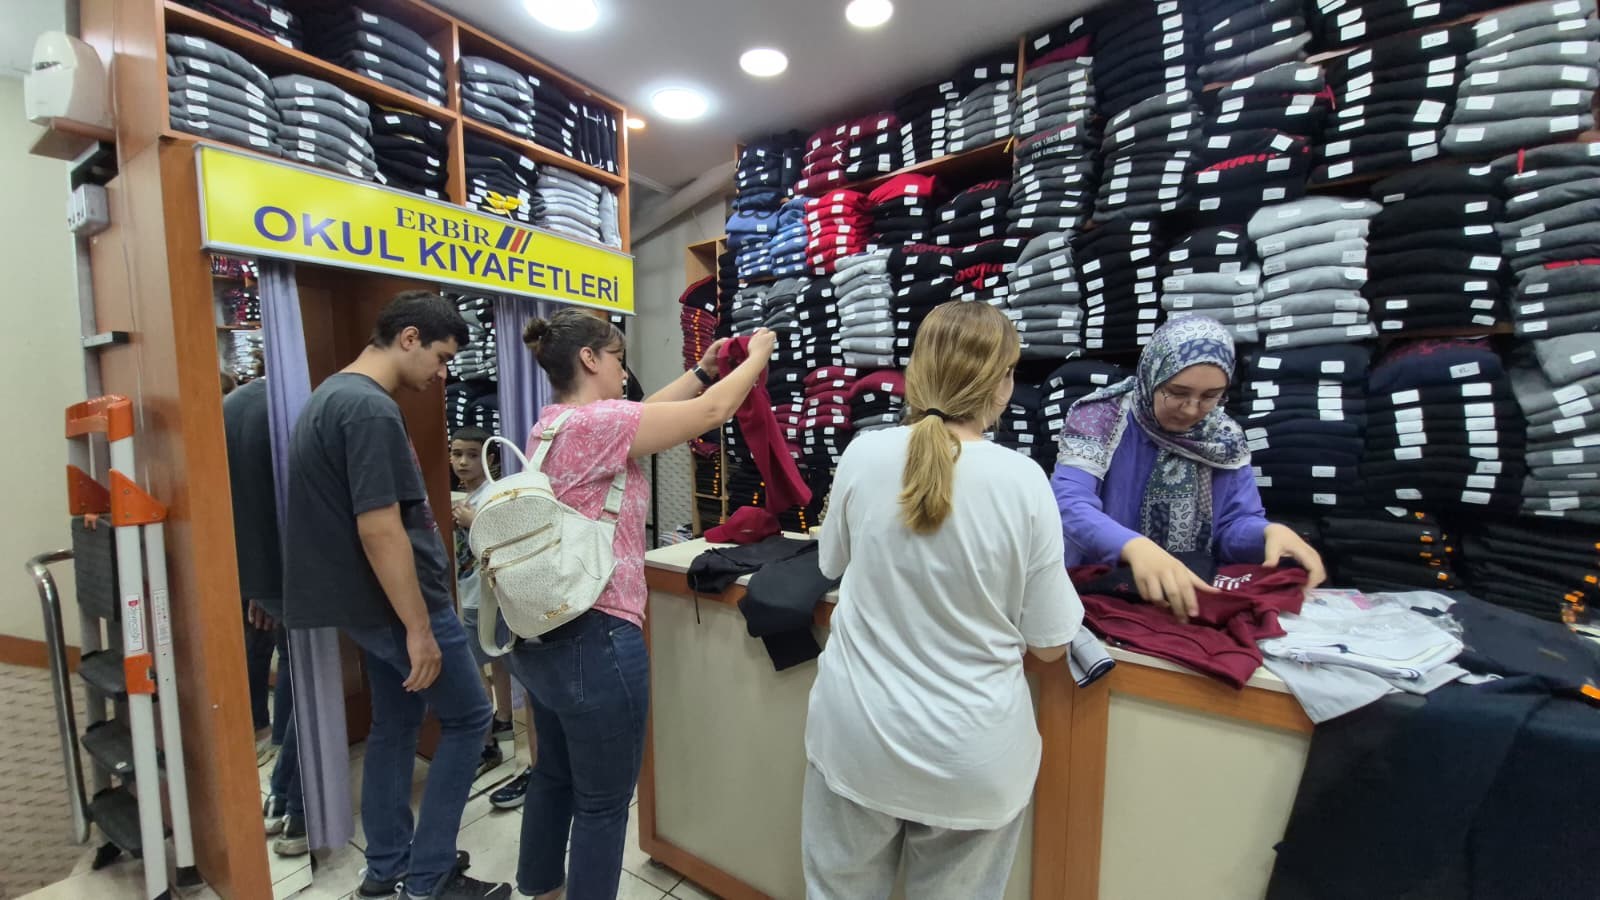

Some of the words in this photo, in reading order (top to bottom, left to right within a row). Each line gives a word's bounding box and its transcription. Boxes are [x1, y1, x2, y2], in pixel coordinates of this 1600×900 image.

[254, 206, 404, 262] OKUL
[419, 237, 618, 302] KIYAFETLERİ
[394, 207, 491, 246] ERBİR
